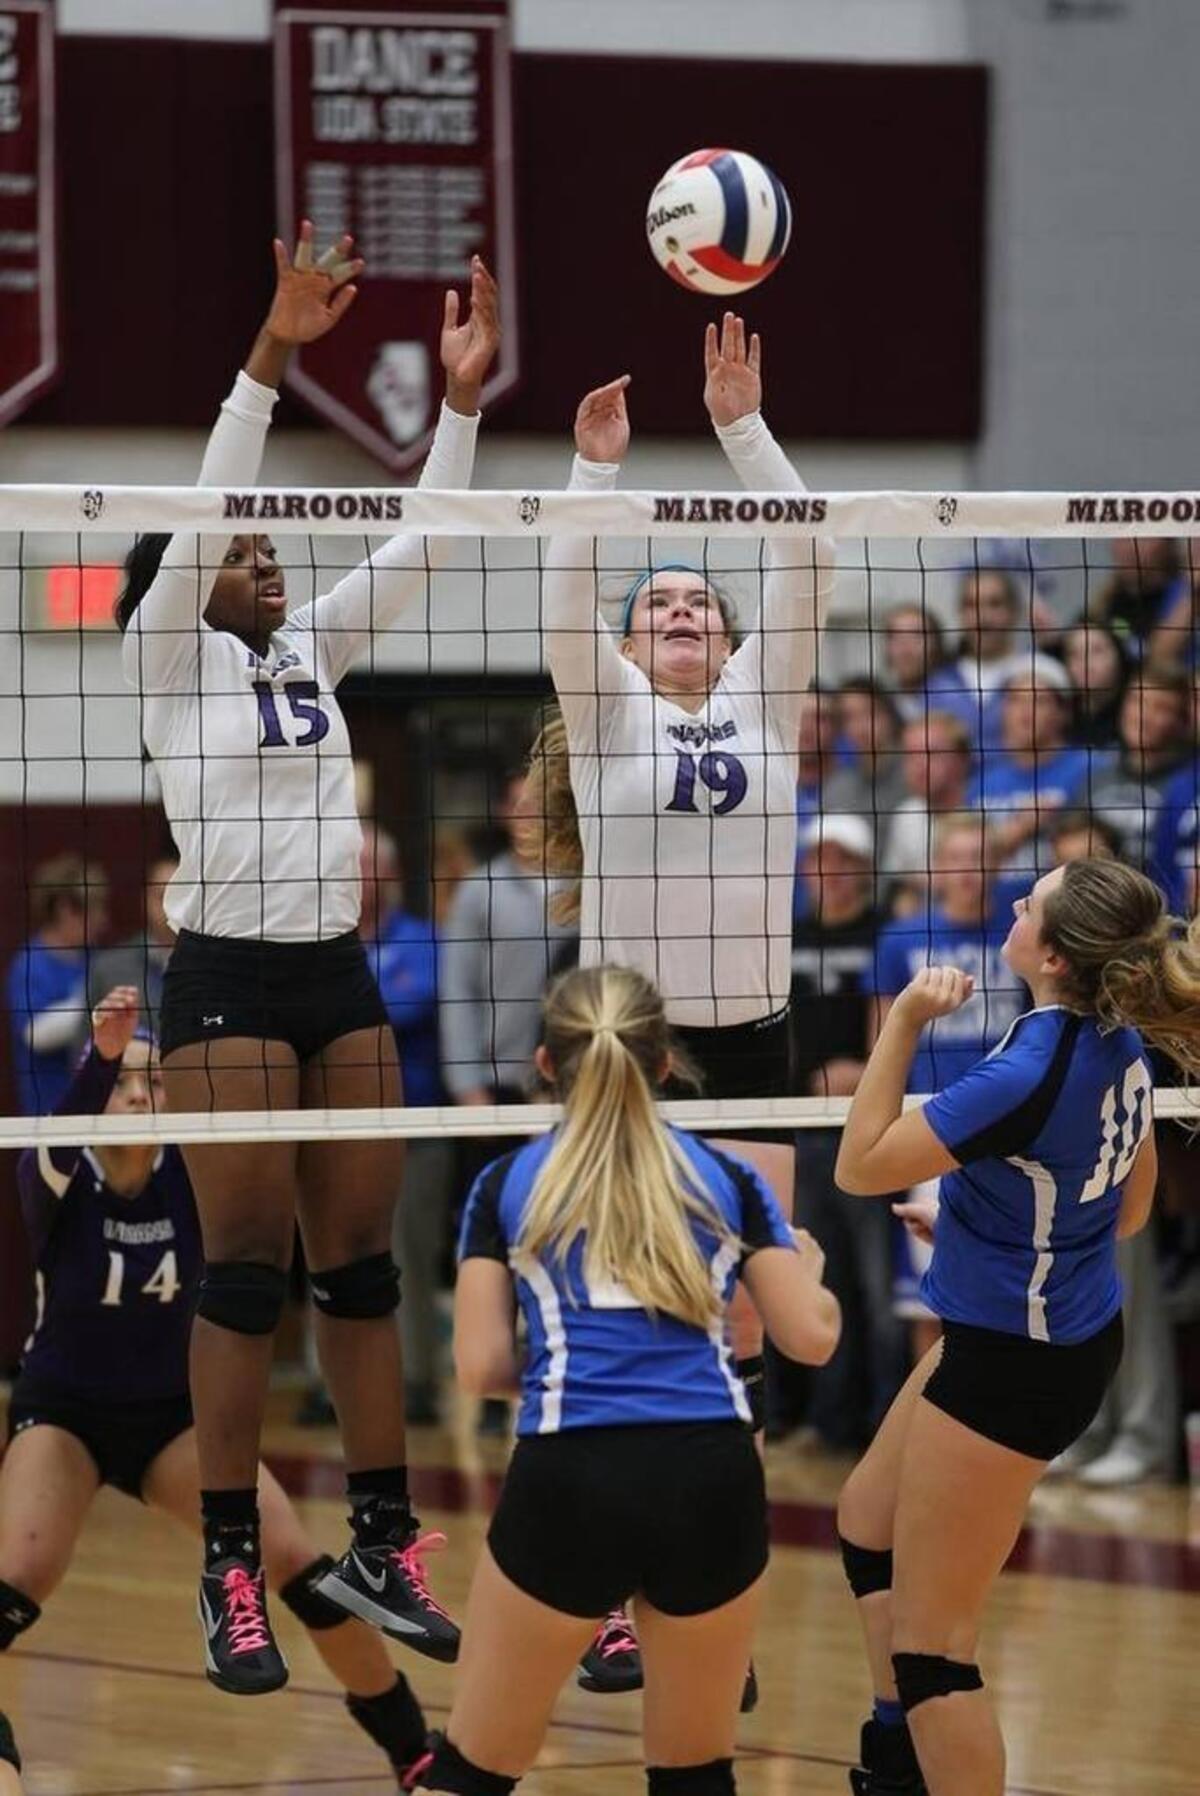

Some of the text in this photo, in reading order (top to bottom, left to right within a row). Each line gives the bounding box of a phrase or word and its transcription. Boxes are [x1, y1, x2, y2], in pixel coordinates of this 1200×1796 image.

[311, 27, 478, 93] DANCE
[383, 99, 478, 144] STATE
[223, 493, 403, 520] MAROONS
[653, 498, 827, 523] MAROONS
[251, 680, 329, 747] 15
[664, 747, 747, 815] 19
[1079, 1056, 1152, 1204] 10
[101, 1249, 181, 1306] 14
